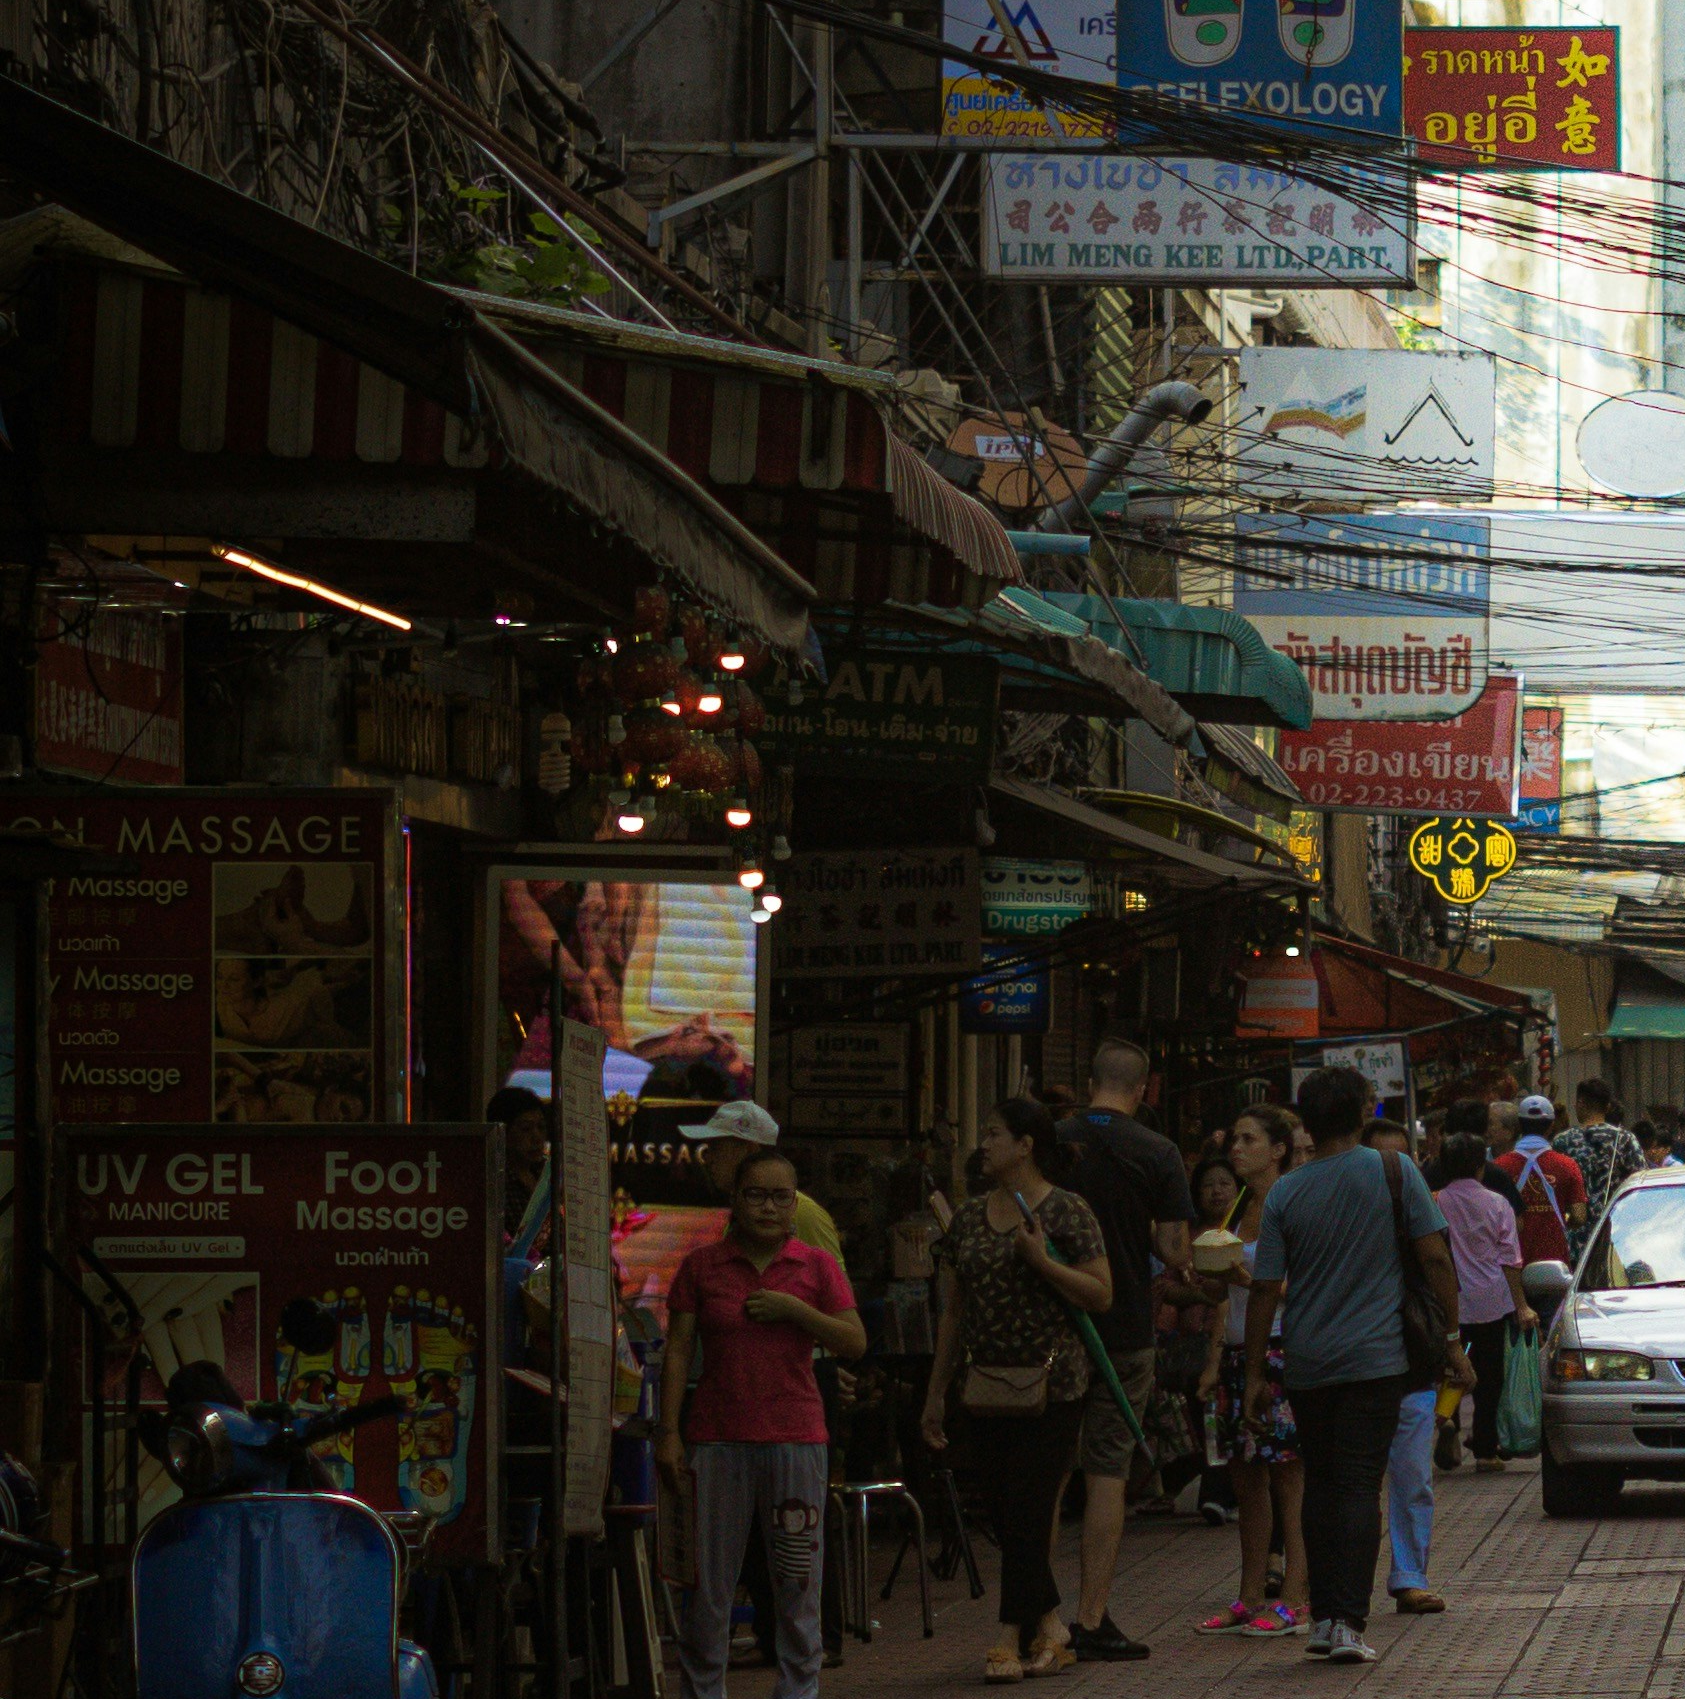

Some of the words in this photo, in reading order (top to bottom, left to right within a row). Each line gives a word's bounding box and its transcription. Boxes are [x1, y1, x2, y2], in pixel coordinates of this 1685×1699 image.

[1421, 35, 1545, 75] ราดหน้า
[1555, 35, 1611, 156] 如意
[1003, 243, 1055, 268] LIM
[1068, 243, 1152, 268] MENG
[1165, 244, 1223, 269] KEE
[824, 661, 943, 707] ATM
[1282, 728, 1511, 782] เครื่องเขียน
[1310, 783, 1482, 811] 02-223-9437
[117, 814, 362, 856] MASSAGE
[68, 877, 189, 905] Massage
[987, 911, 1080, 934] Drugsto
[73, 966, 195, 999] Massage
[997, 1001, 1032, 1016] pepsi
[60, 1060, 182, 1093] Massage
[77, 1153, 149, 1196] UV
[165, 1152, 265, 1196] GEL
[324, 1150, 443, 1196] Foot
[108, 1201, 231, 1222] MANICURE
[296, 1200, 470, 1239] Massage
[181, 1241, 203, 1254] UV
[207, 1241, 231, 1254] Gel
